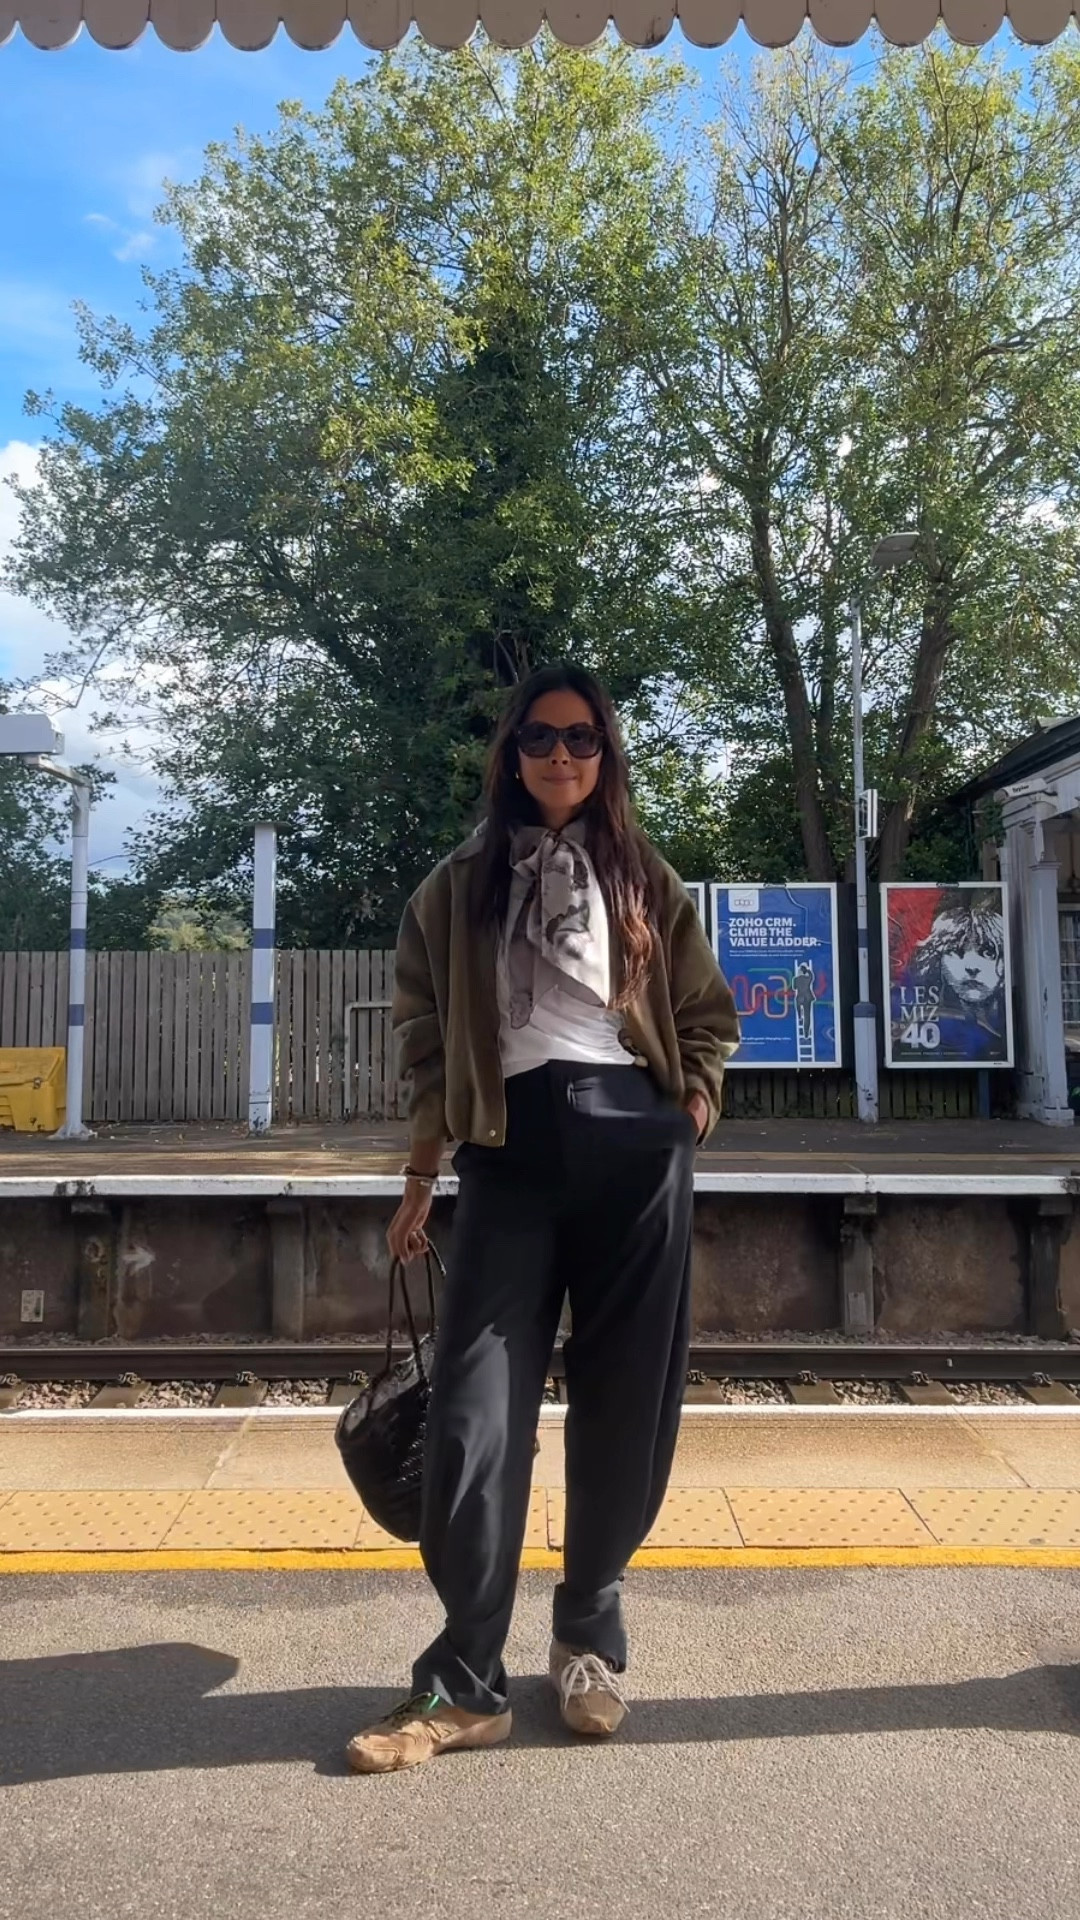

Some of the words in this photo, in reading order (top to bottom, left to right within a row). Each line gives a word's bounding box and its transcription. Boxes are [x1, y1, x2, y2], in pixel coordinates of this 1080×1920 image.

[729, 918, 763, 927] ZOHO
[765, 918, 796, 927] CRM.
[729, 928, 767, 937] CLIMB
[769, 928, 792, 937] THE
[729, 938, 768, 947] VALUE
[770, 937, 821, 947] LADDER.
[900, 985, 940, 1005] LES
[900, 1006, 939, 1022] MIZ
[901, 1022, 940, 1049] 40
